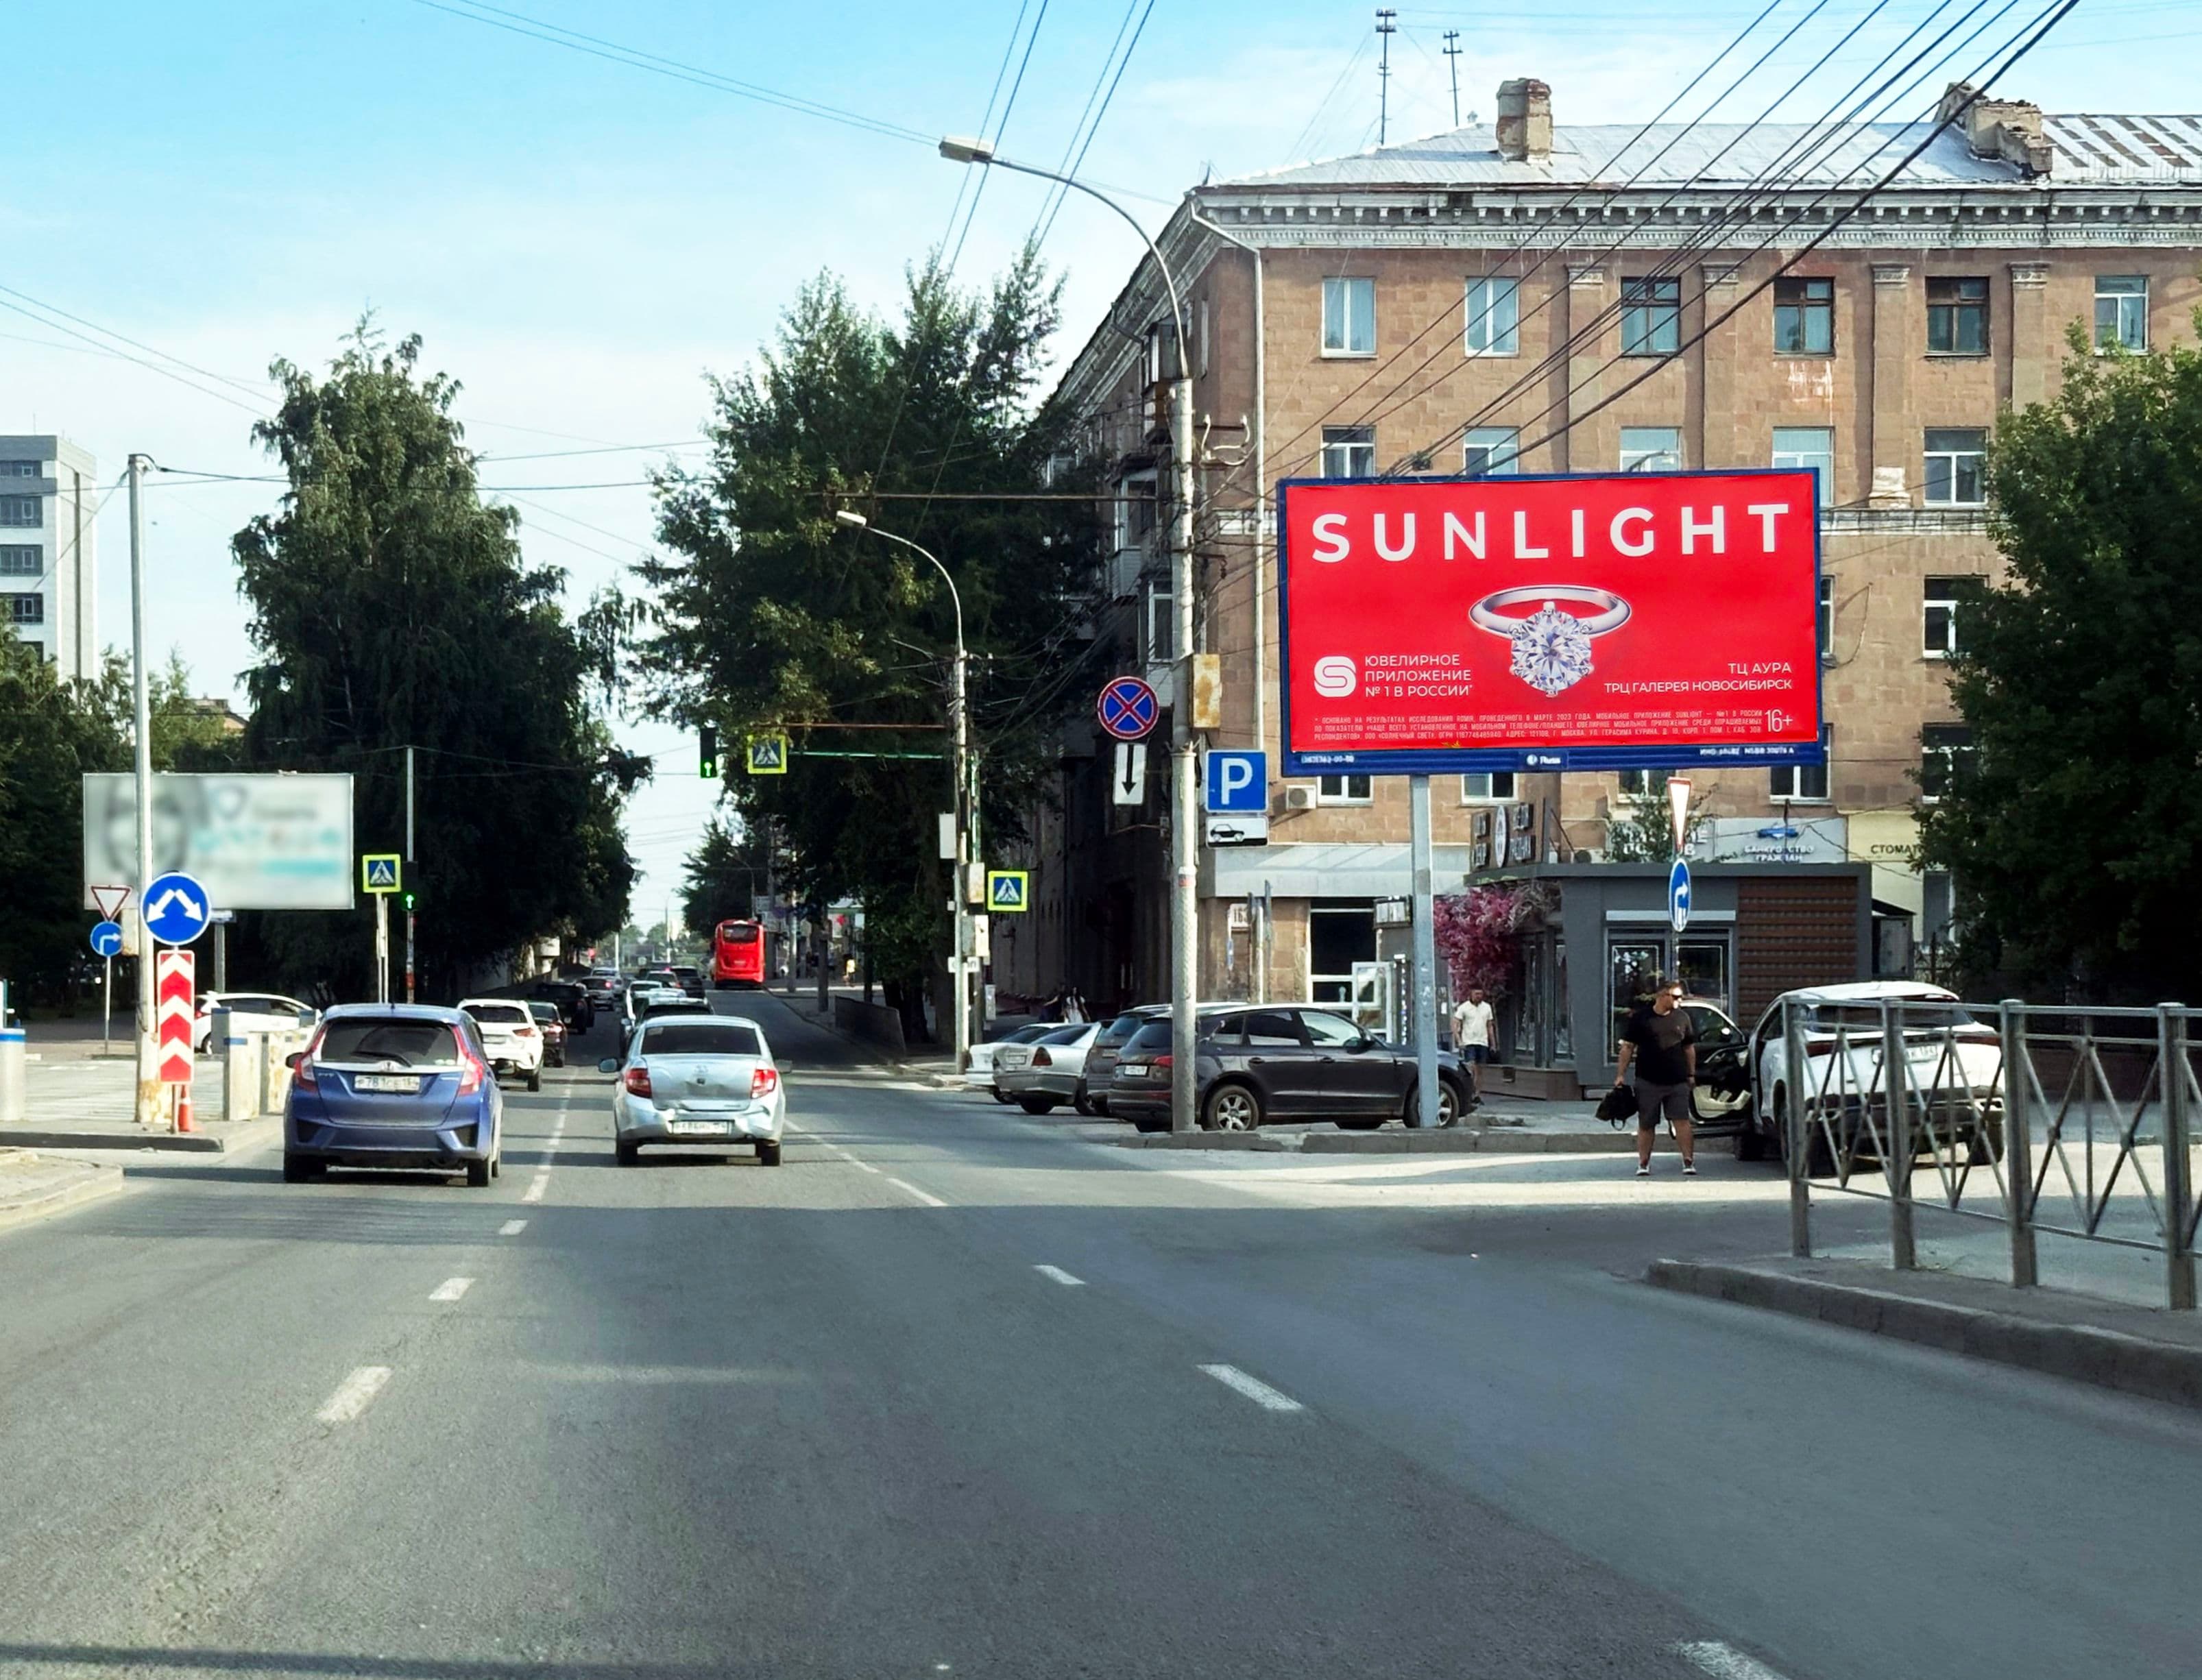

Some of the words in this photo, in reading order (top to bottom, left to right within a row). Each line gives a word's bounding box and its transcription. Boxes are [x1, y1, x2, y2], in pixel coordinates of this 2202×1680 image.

[1312, 503, 1789, 563] SUNLIGHT
[1365, 654, 1460, 667] ЮВЕЛИРНОЕ
[1365, 669, 1471, 682] ПРИЛОЖЕНИЕ
[1728, 663, 1748, 676] ТЦ
[1752, 662, 1791, 674] АУРА
[1394, 685, 1403, 697] В
[1604, 683, 1630, 695] ТРЦ
[1632, 681, 1689, 692] ГАЛЕРЕЯ
[1692, 679, 1792, 692] НОВОСИБИРСК
[1765, 709, 1793, 733] 16+
[1221, 757, 1253, 805] P
